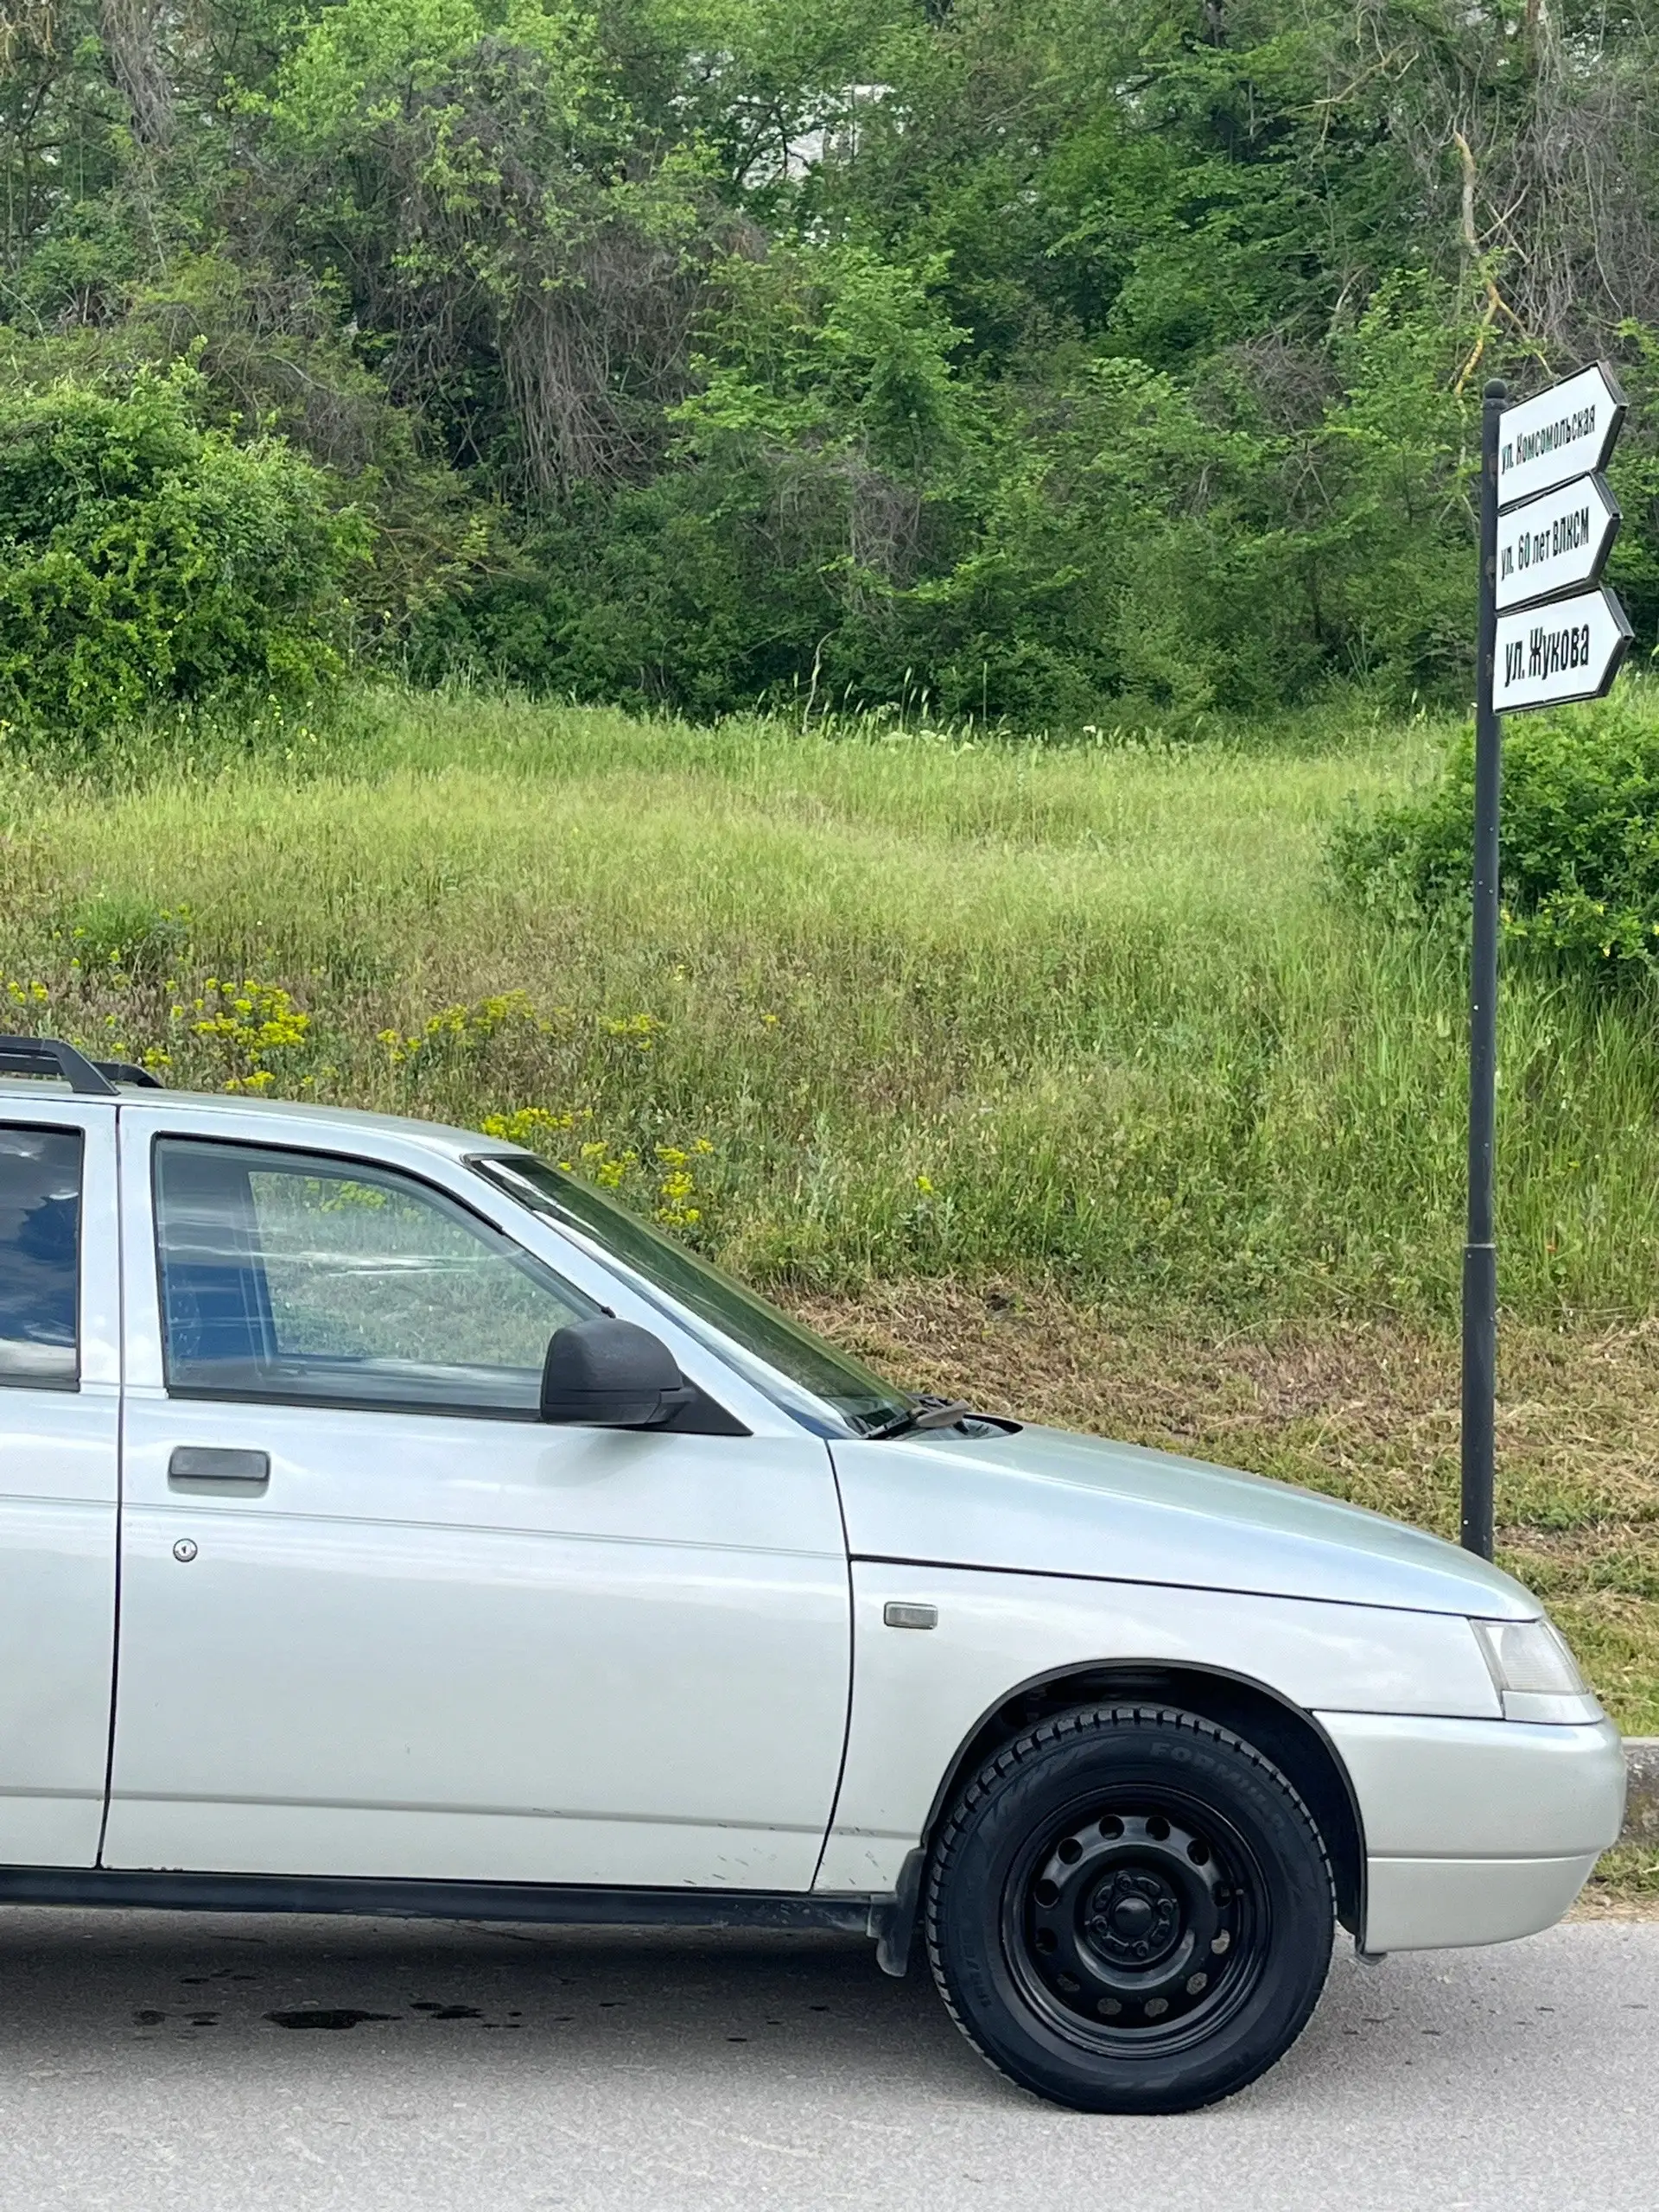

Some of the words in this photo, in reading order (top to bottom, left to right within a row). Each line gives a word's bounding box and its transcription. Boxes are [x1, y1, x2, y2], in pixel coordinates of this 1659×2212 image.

[1502, 442, 1514, 475] ул.
[1516, 404, 1595, 466] Комсомольская
[1501, 545, 1514, 582] ул.
[1518, 531, 1530, 570] 60
[1532, 529, 1551, 565] лет
[1553, 505, 1589, 557] ВЛКСМ
[1504, 640, 1525, 688] ул.
[1528, 623, 1590, 681] Жукова
